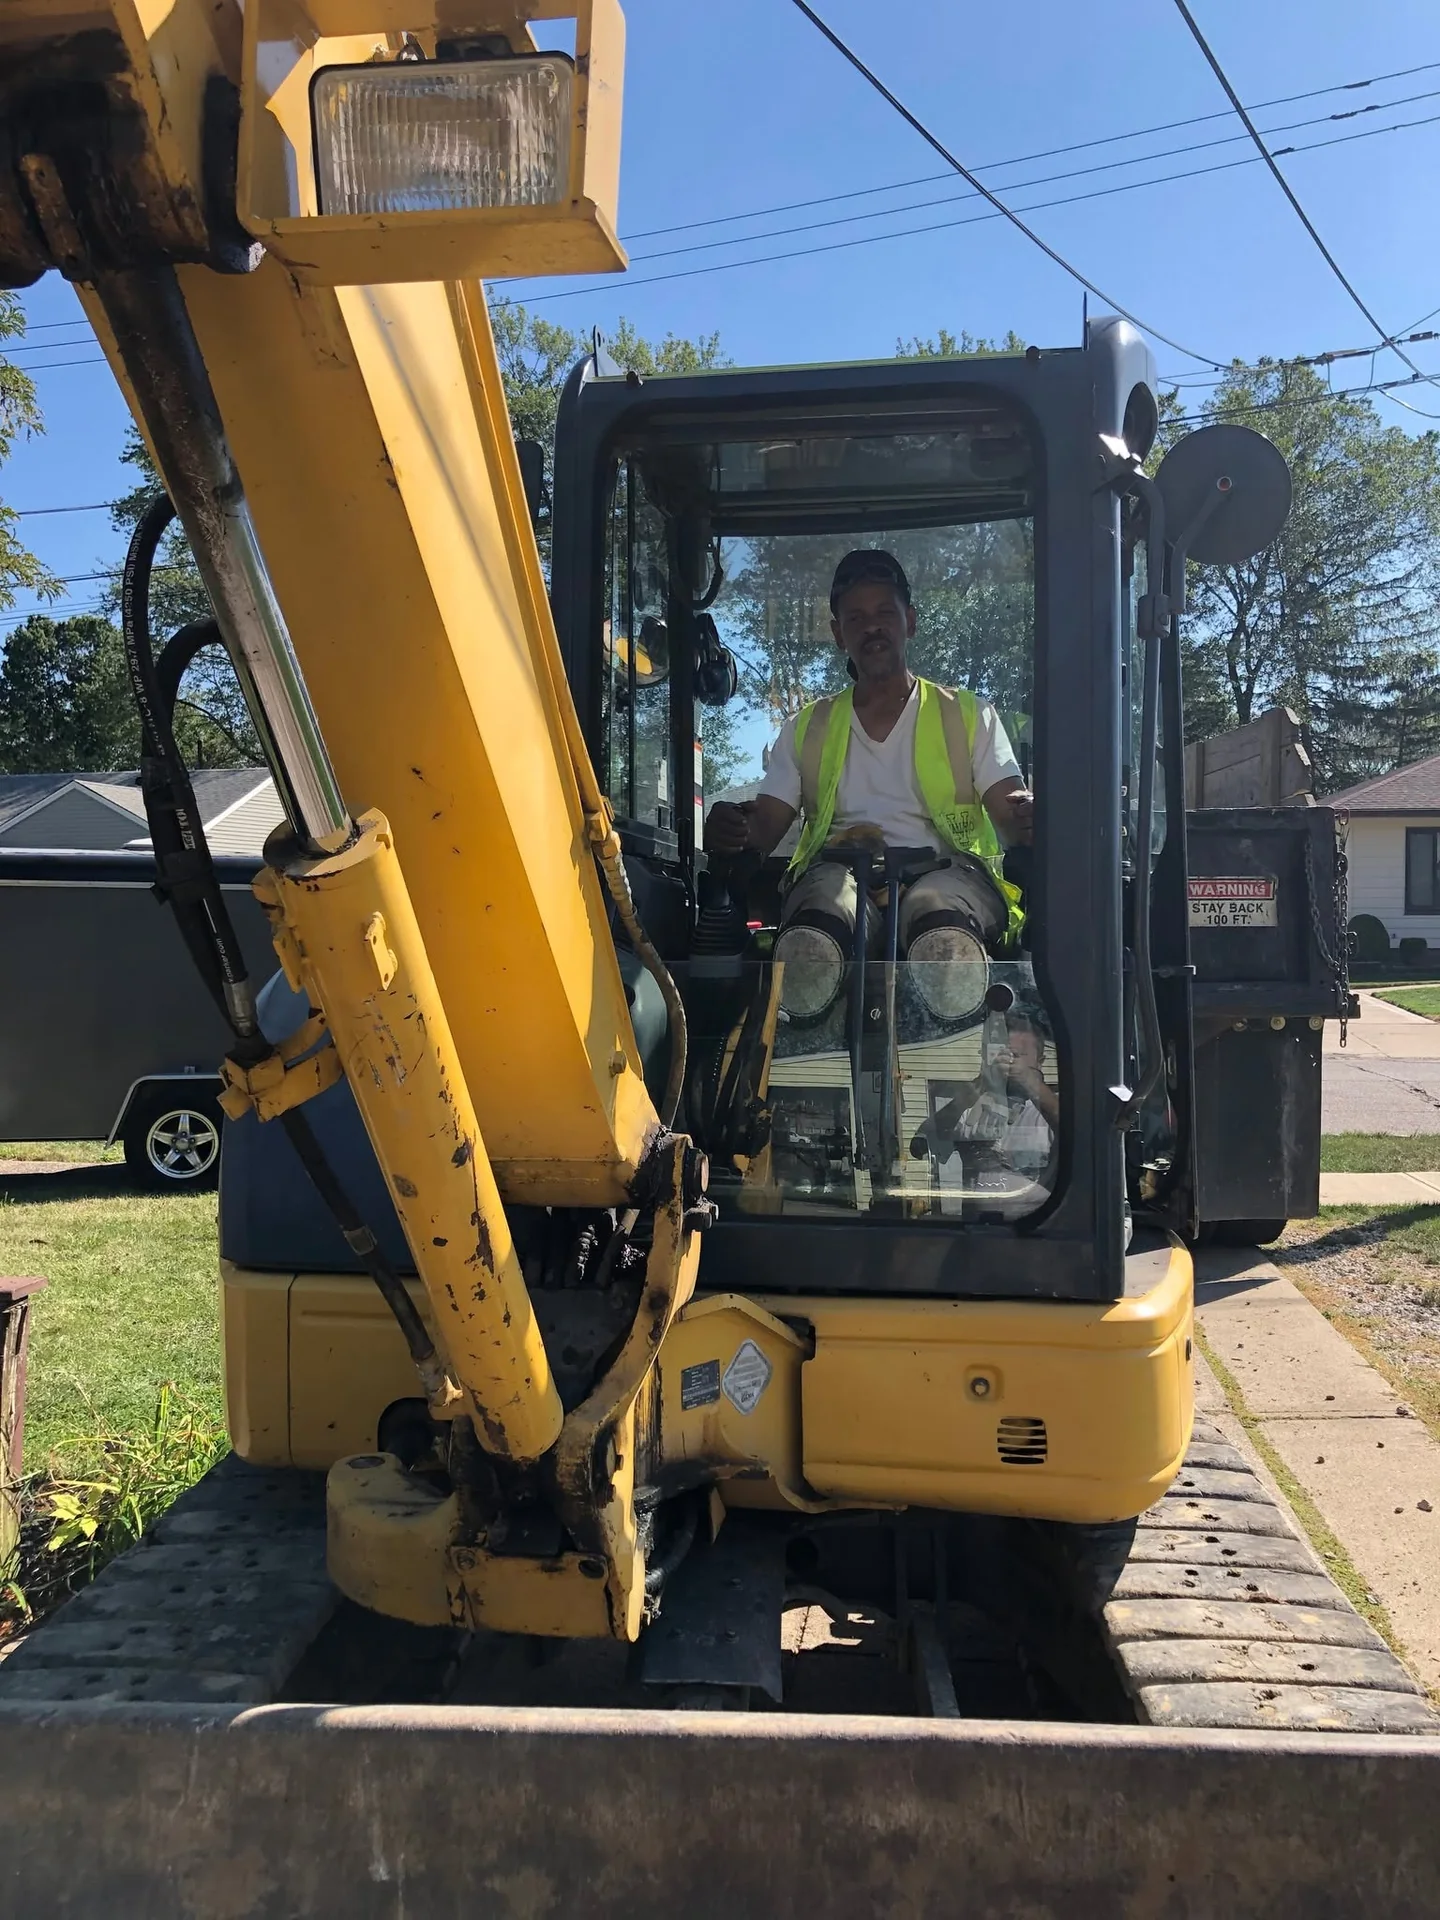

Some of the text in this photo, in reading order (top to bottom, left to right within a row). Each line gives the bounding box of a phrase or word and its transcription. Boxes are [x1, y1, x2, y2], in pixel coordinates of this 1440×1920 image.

[128, 529, 144, 561] MSHA
[125, 620, 136, 646] MPa
[133, 675, 145, 694] WP
[1189, 884, 1266, 895] WARNING
[1192, 903, 1264, 914] STAY BACK
[1207, 914, 1228, 925] 100
